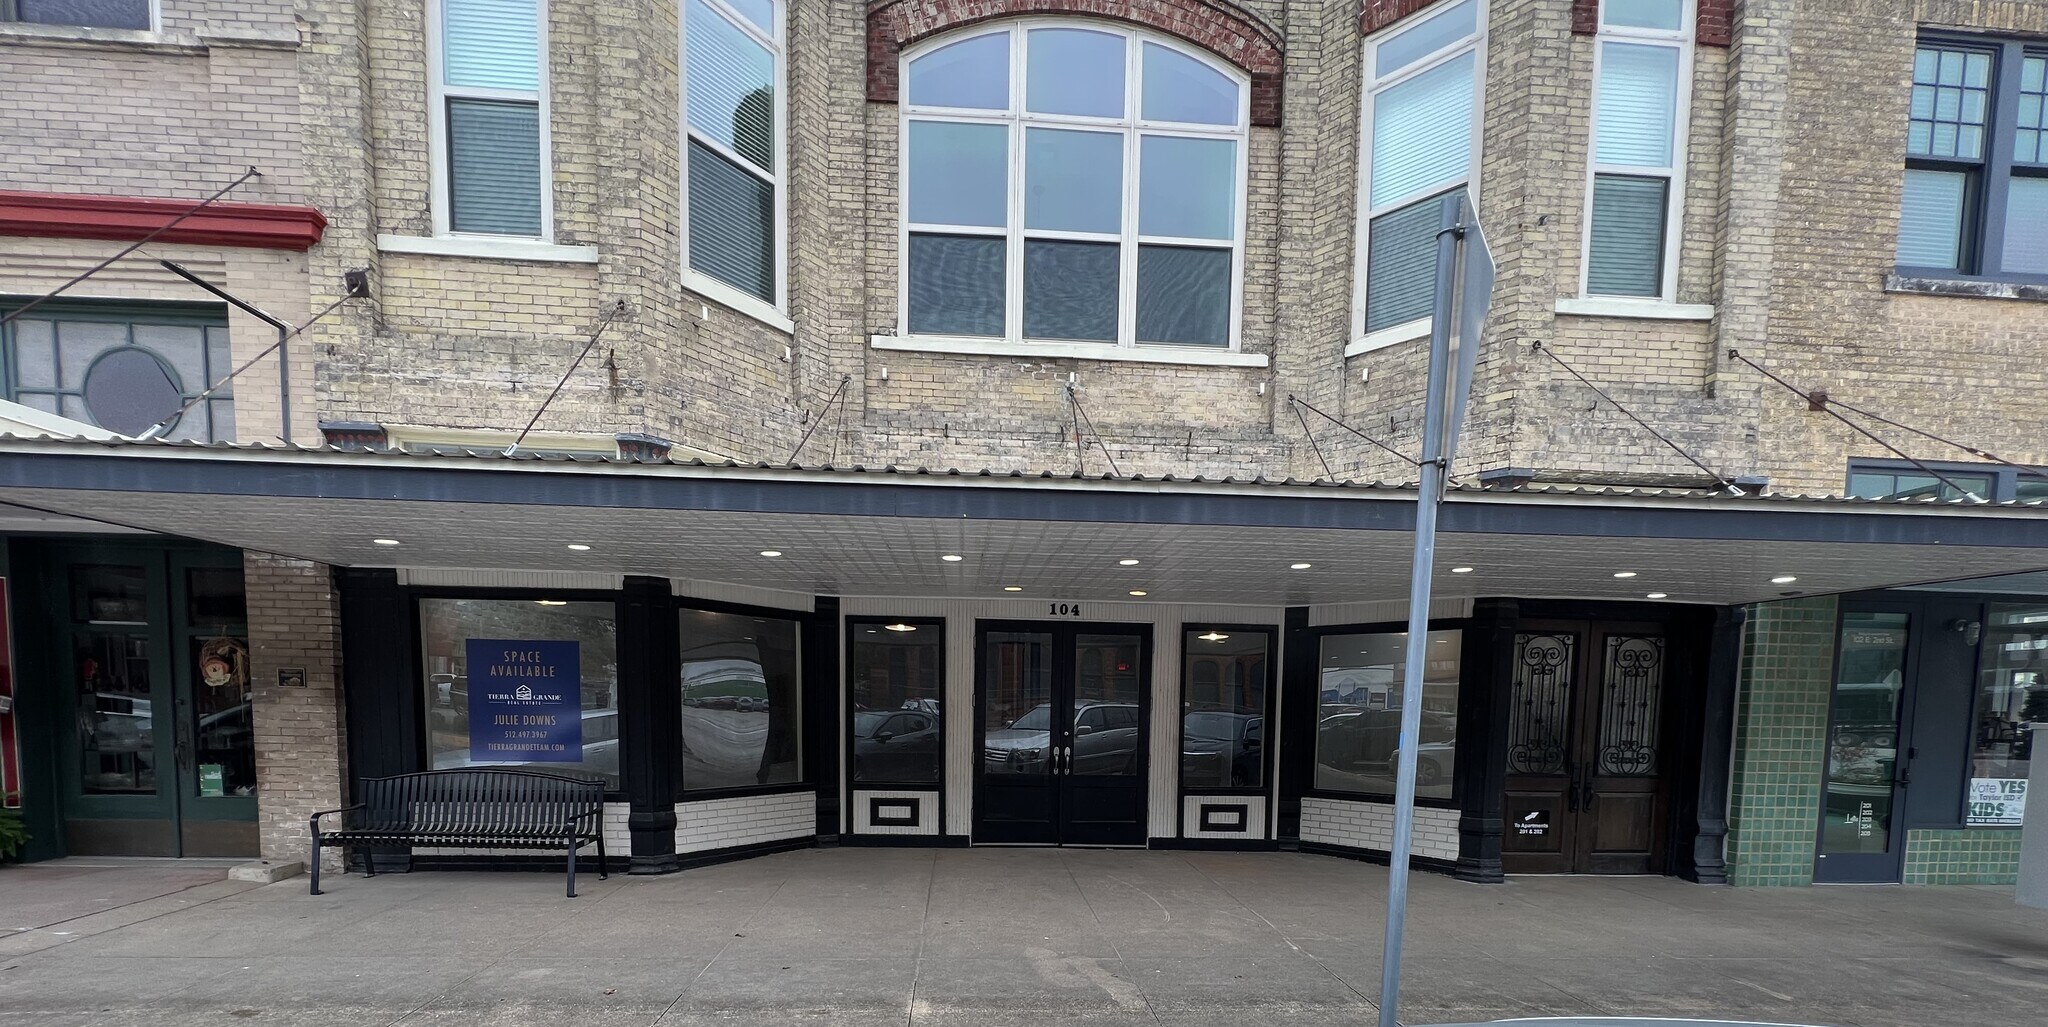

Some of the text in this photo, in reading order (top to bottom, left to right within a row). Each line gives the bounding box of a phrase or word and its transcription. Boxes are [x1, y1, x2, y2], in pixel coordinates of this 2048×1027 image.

[1049, 603, 1080, 616] 104
[504, 651, 540, 662] SPACE
[490, 666, 555, 677] AVAILABLE
[494, 715, 556, 726] JULIE DOWNS
[504, 730, 548, 739] 512.497.3967
[488, 743, 565, 751] TIERRAGRANDETEAM.COM
[1971, 780, 2026, 794] Vote YES
[1968, 802, 2005, 817] KIDS
